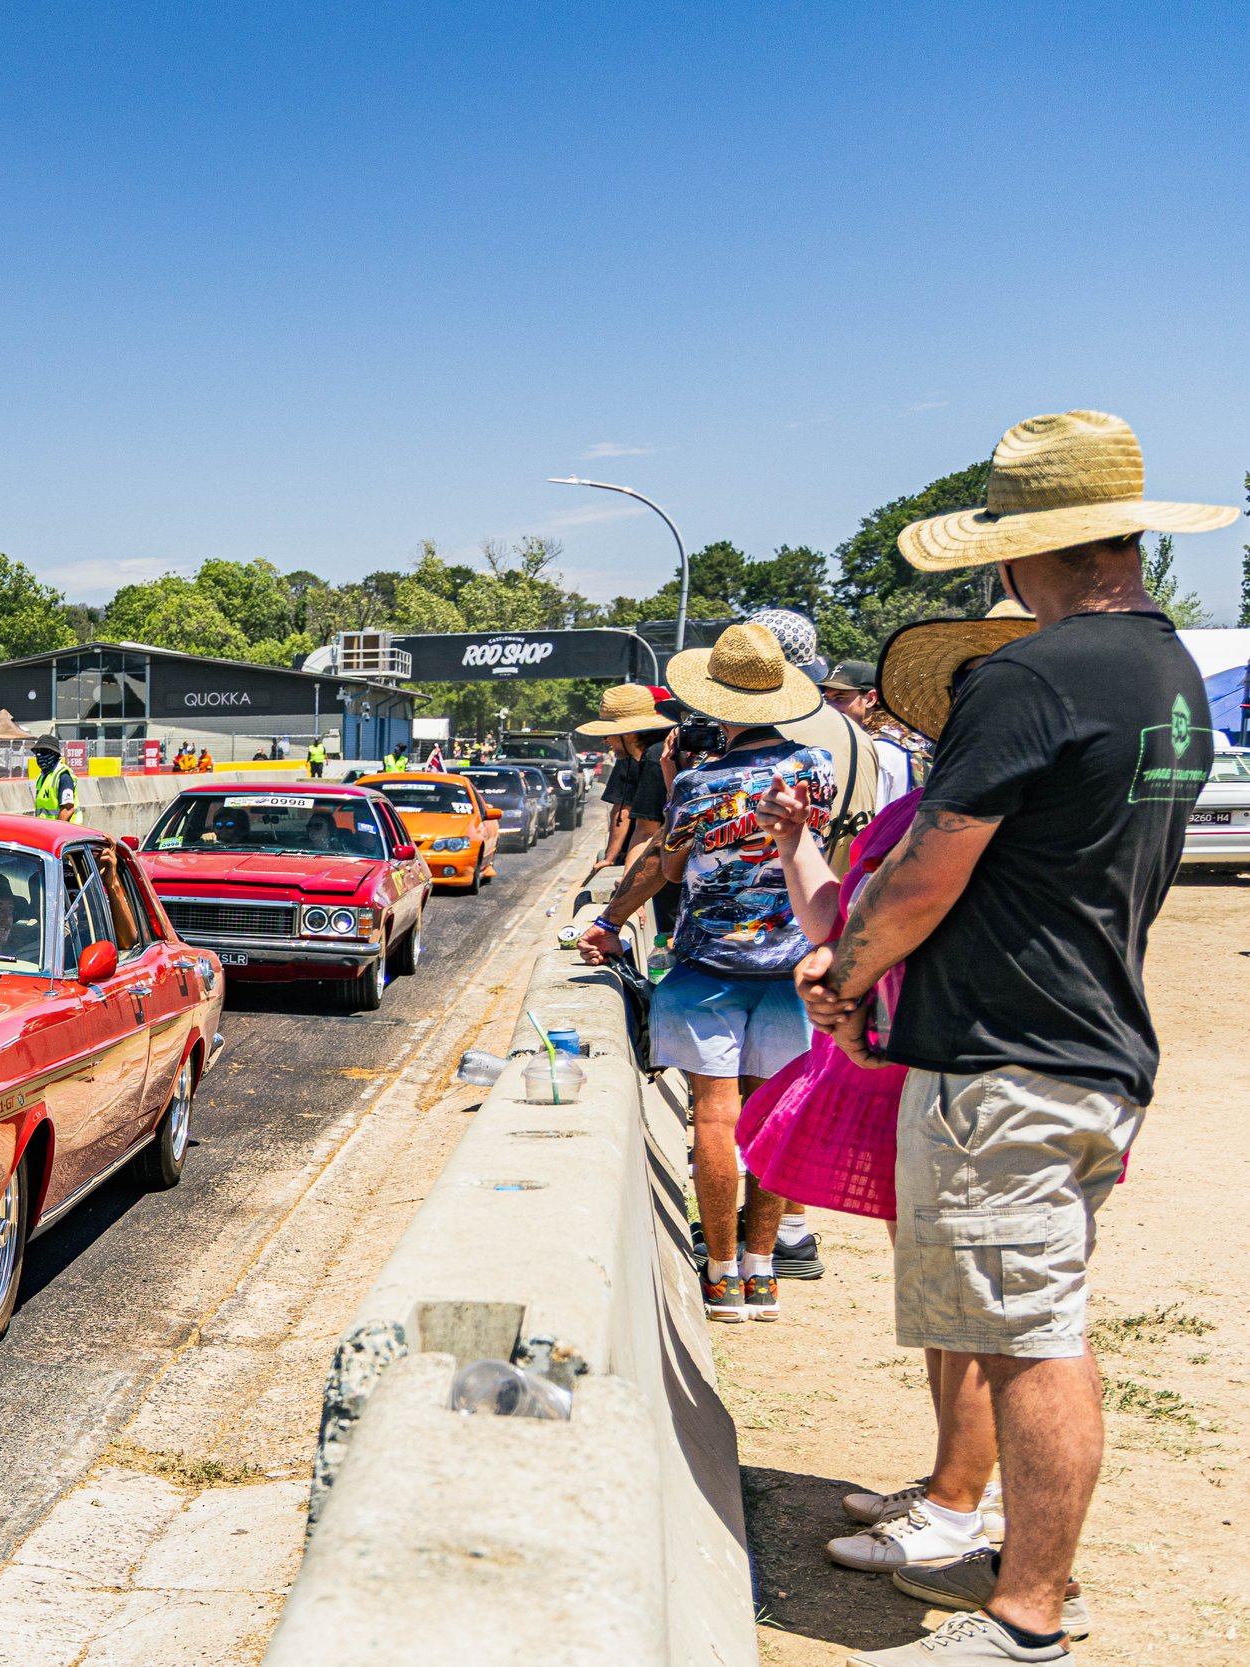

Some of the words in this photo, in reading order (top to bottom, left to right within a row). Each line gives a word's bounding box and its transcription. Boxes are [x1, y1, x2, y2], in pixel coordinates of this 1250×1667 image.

[461, 644, 503, 666] ROD
[500, 642, 553, 665] SHOP
[184, 692, 251, 706] QUOKKA
[66, 748, 84, 758] STOP
[145, 748, 158, 758] STOP
[145, 758, 158, 767] HERE
[270, 798, 306, 806] 0998
